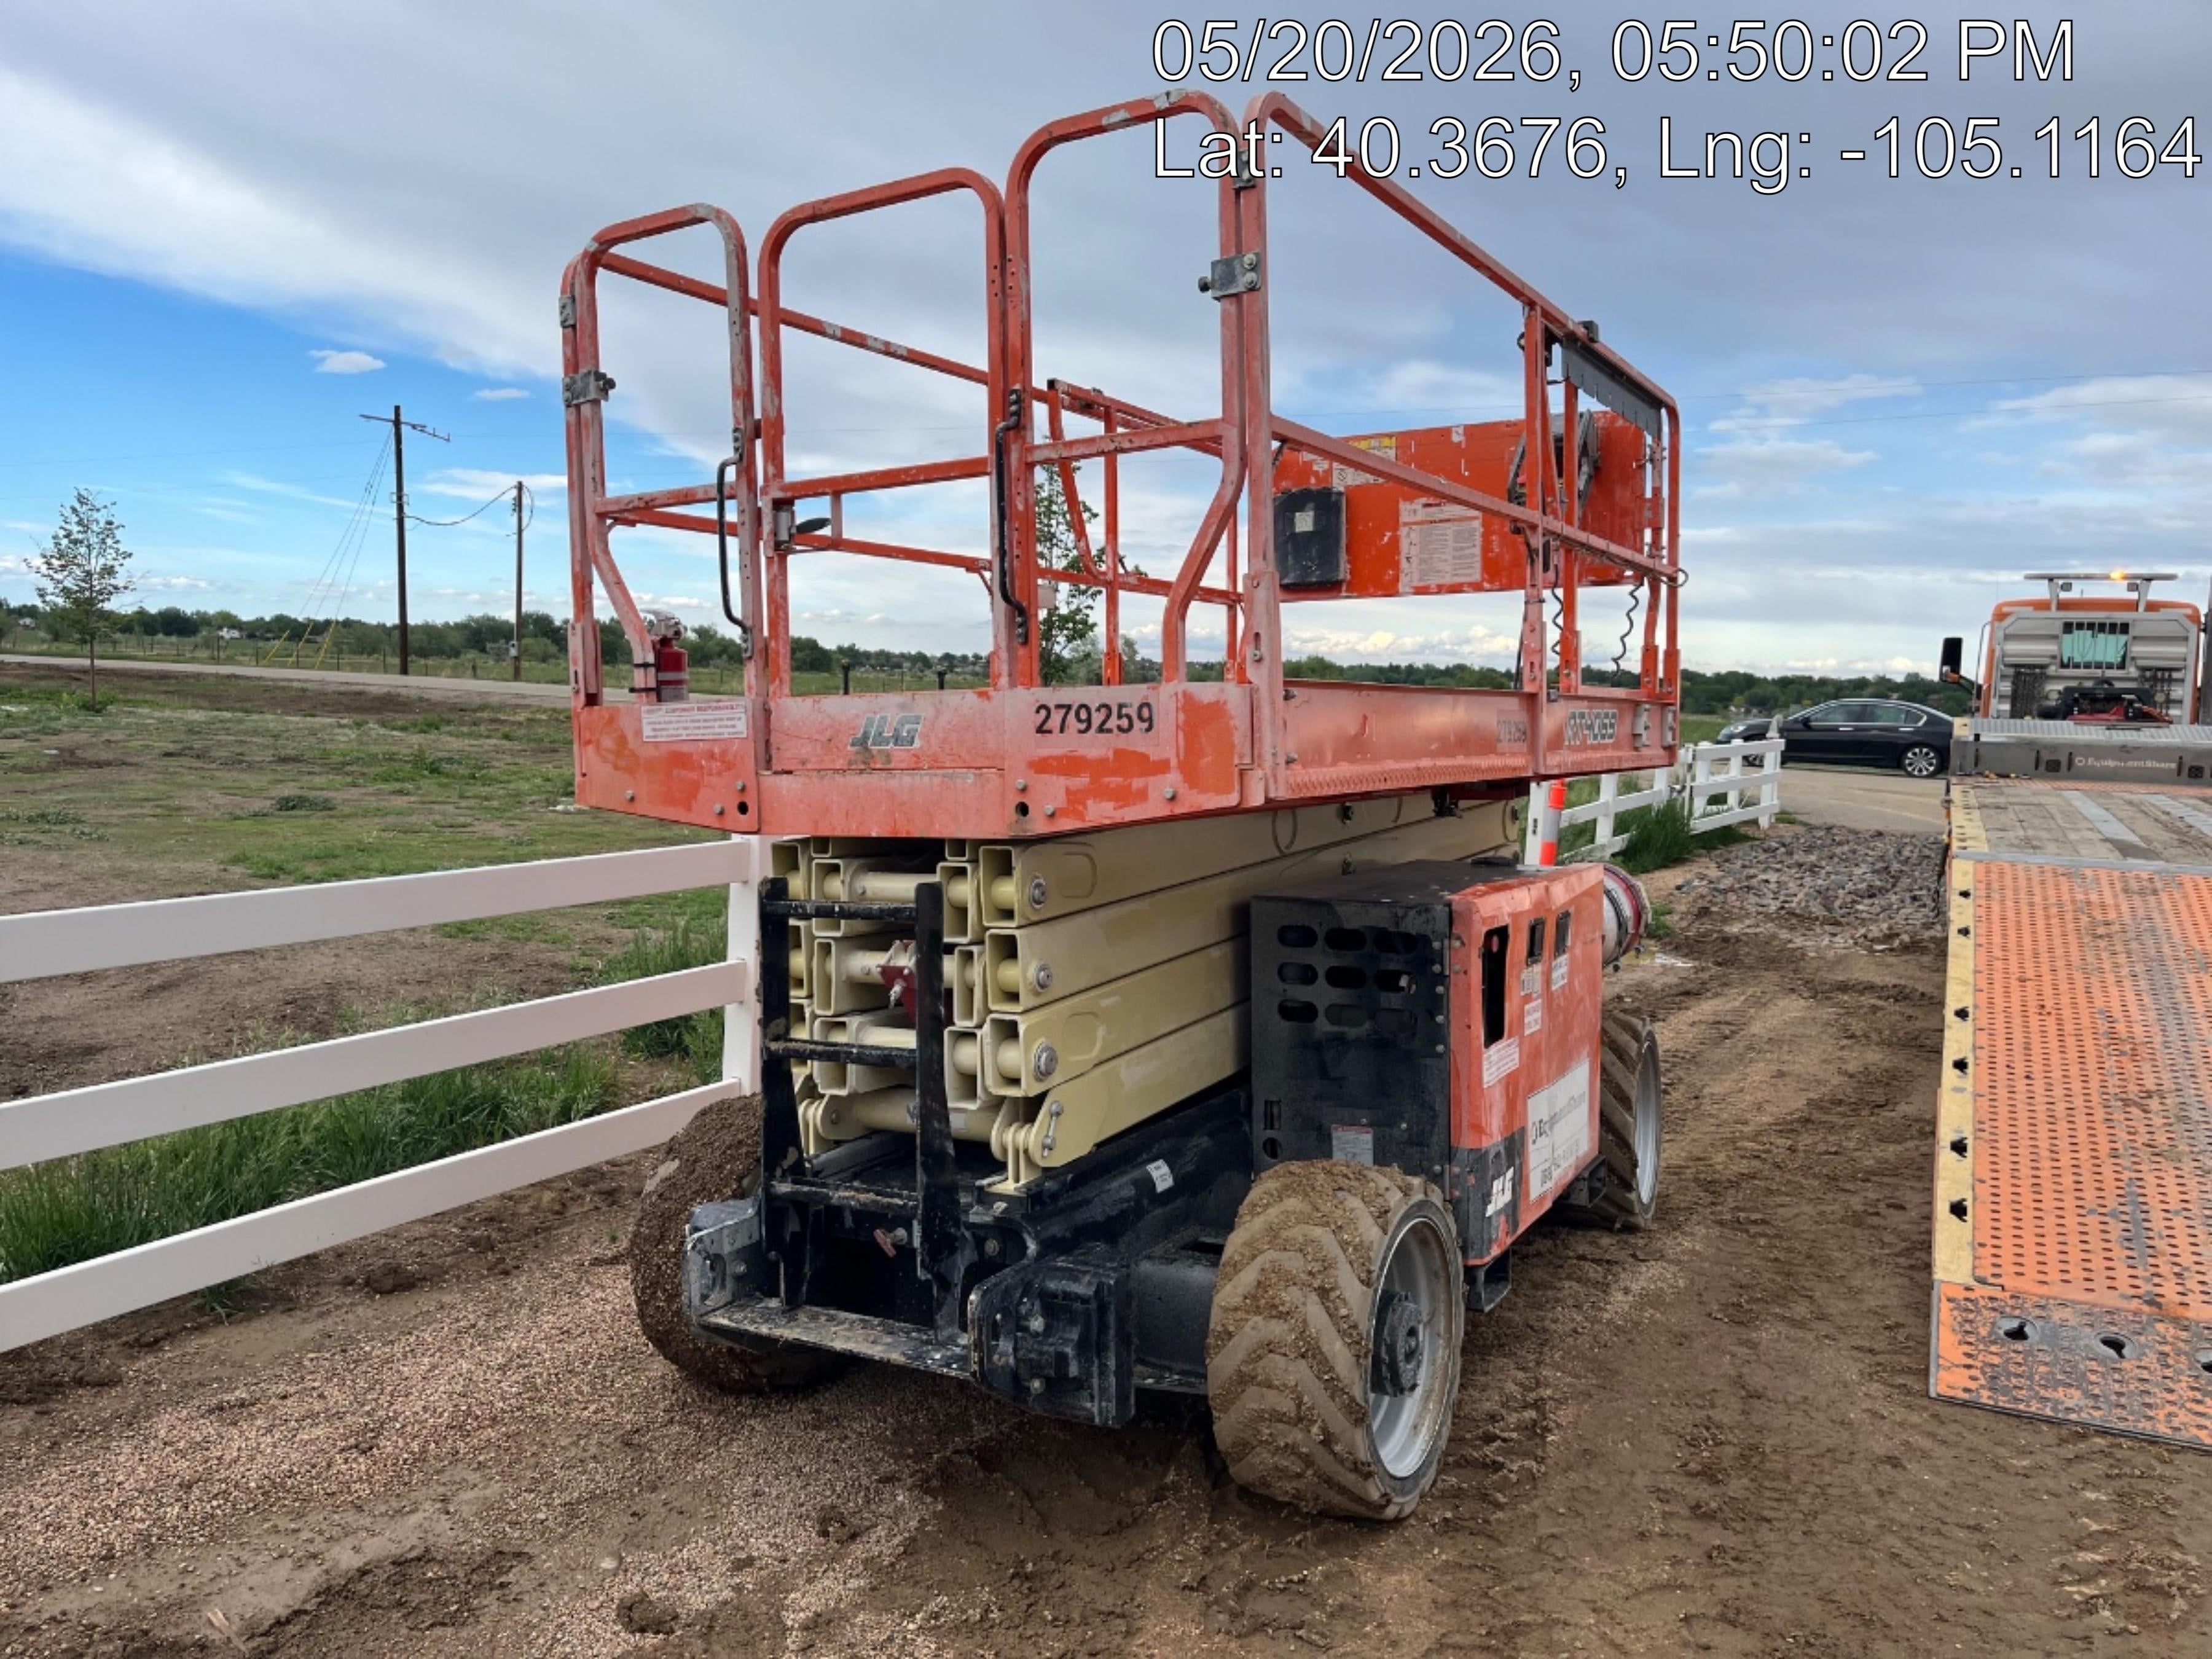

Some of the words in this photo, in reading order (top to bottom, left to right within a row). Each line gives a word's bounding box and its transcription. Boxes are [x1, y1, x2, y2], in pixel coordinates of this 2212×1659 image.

[848, 713, 924, 750] JLG
[1035, 702, 1154, 734] 279259
[1485, 1166, 1514, 1217] JLG
